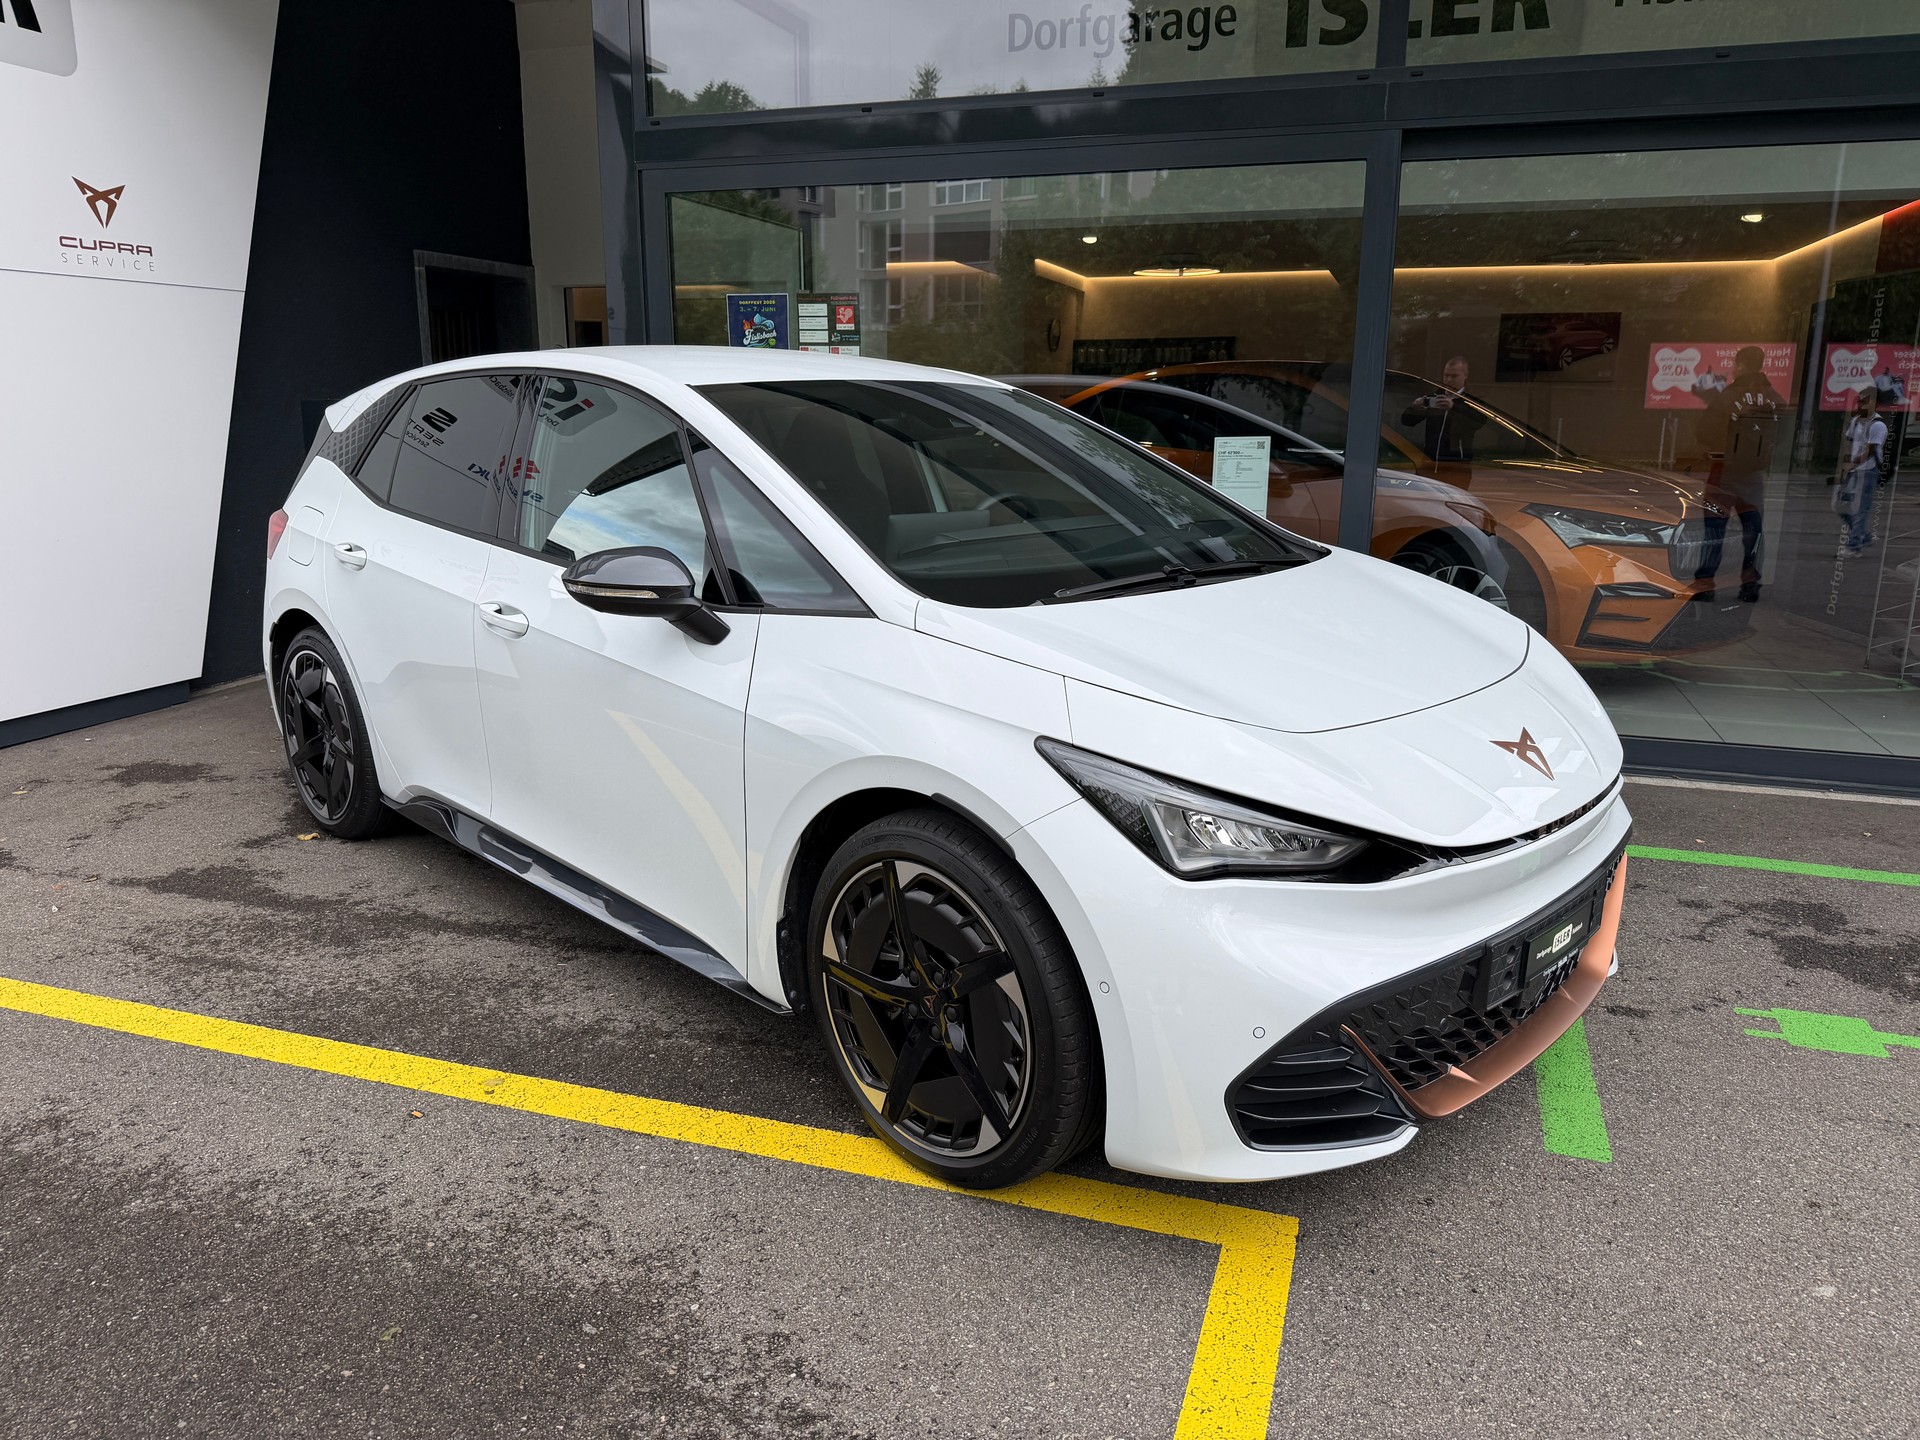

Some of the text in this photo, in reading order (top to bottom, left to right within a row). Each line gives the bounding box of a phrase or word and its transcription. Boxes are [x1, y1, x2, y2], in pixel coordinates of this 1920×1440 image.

[1007, 3, 1238, 59] Dorfgarage
[59, 235, 153, 257] CUPRA
[60, 252, 155, 272] SERVICE
[1826, 523, 1850, 616] Dorfgarage
